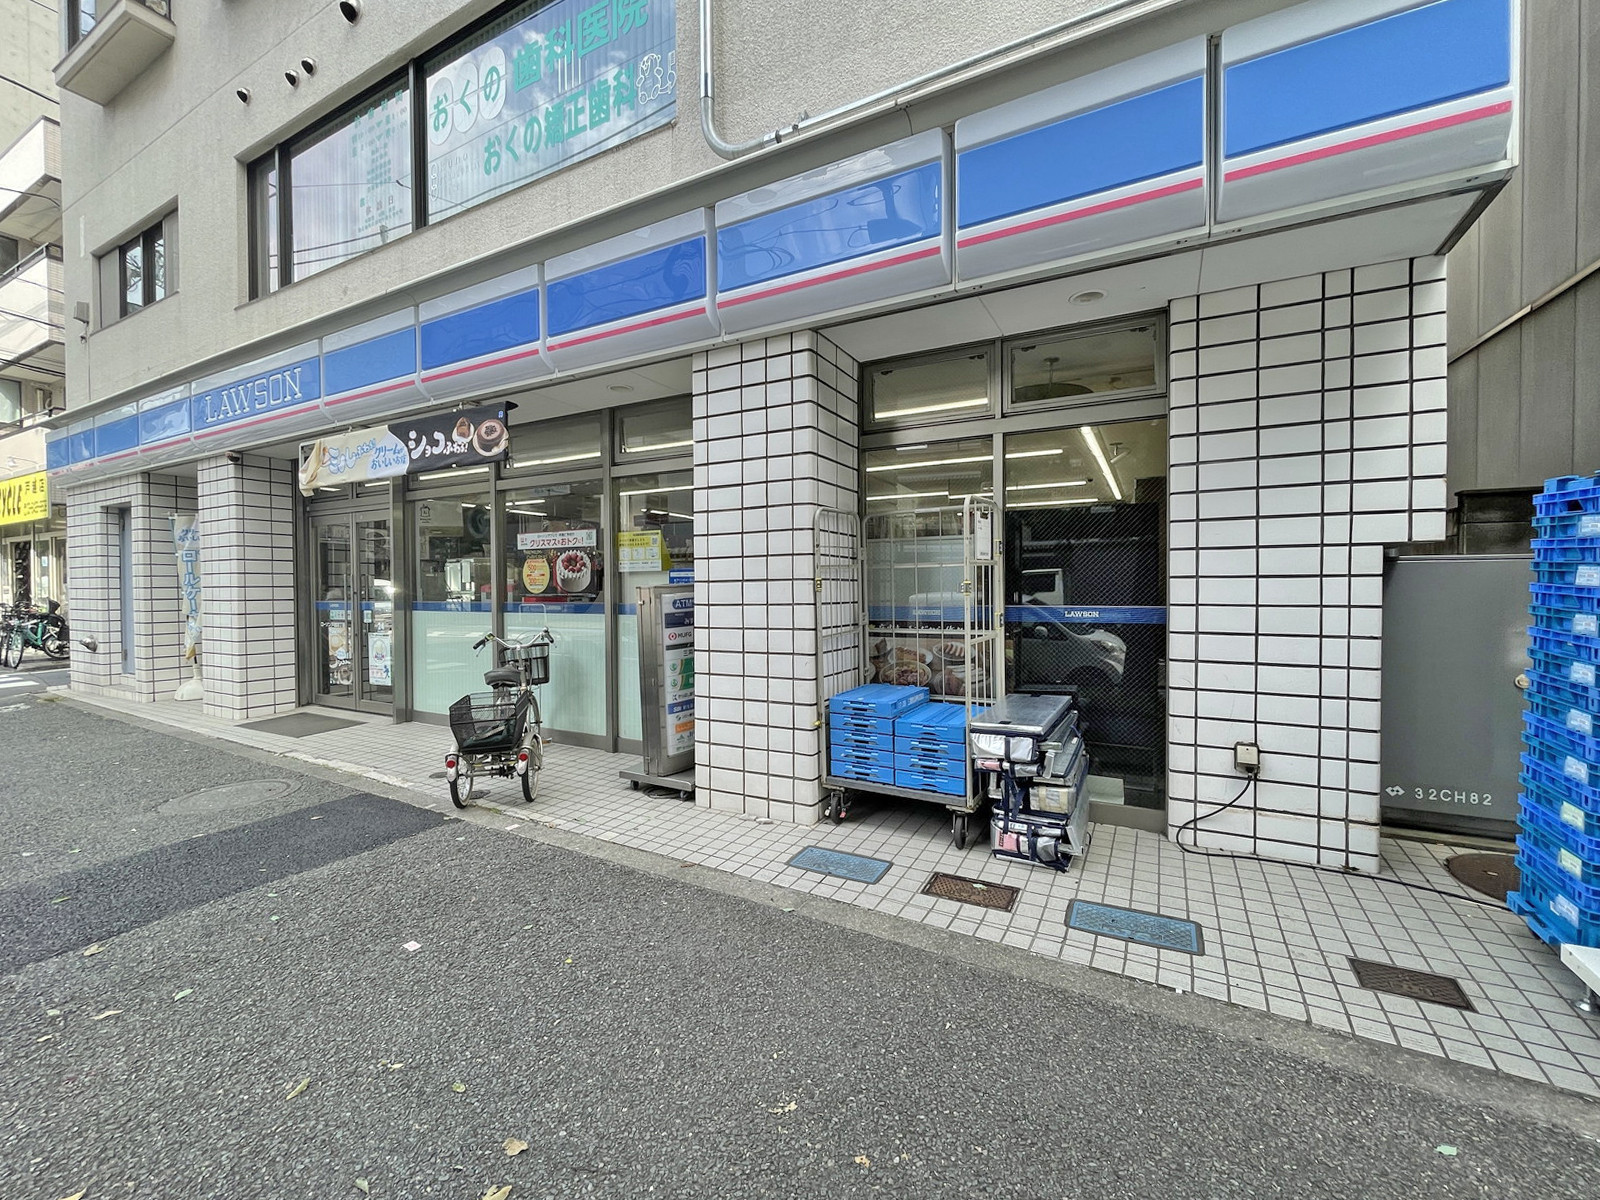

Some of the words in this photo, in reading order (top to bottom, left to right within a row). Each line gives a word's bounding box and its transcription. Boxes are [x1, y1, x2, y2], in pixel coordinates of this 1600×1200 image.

[431, 65, 502, 132] おくの
[483, 61, 637, 176] おくの矯正歯科
[204, 367, 302, 423] LAWSON
[1064, 610, 1099, 618] LAWSON
[1414, 787, 1492, 806] 32CH82
